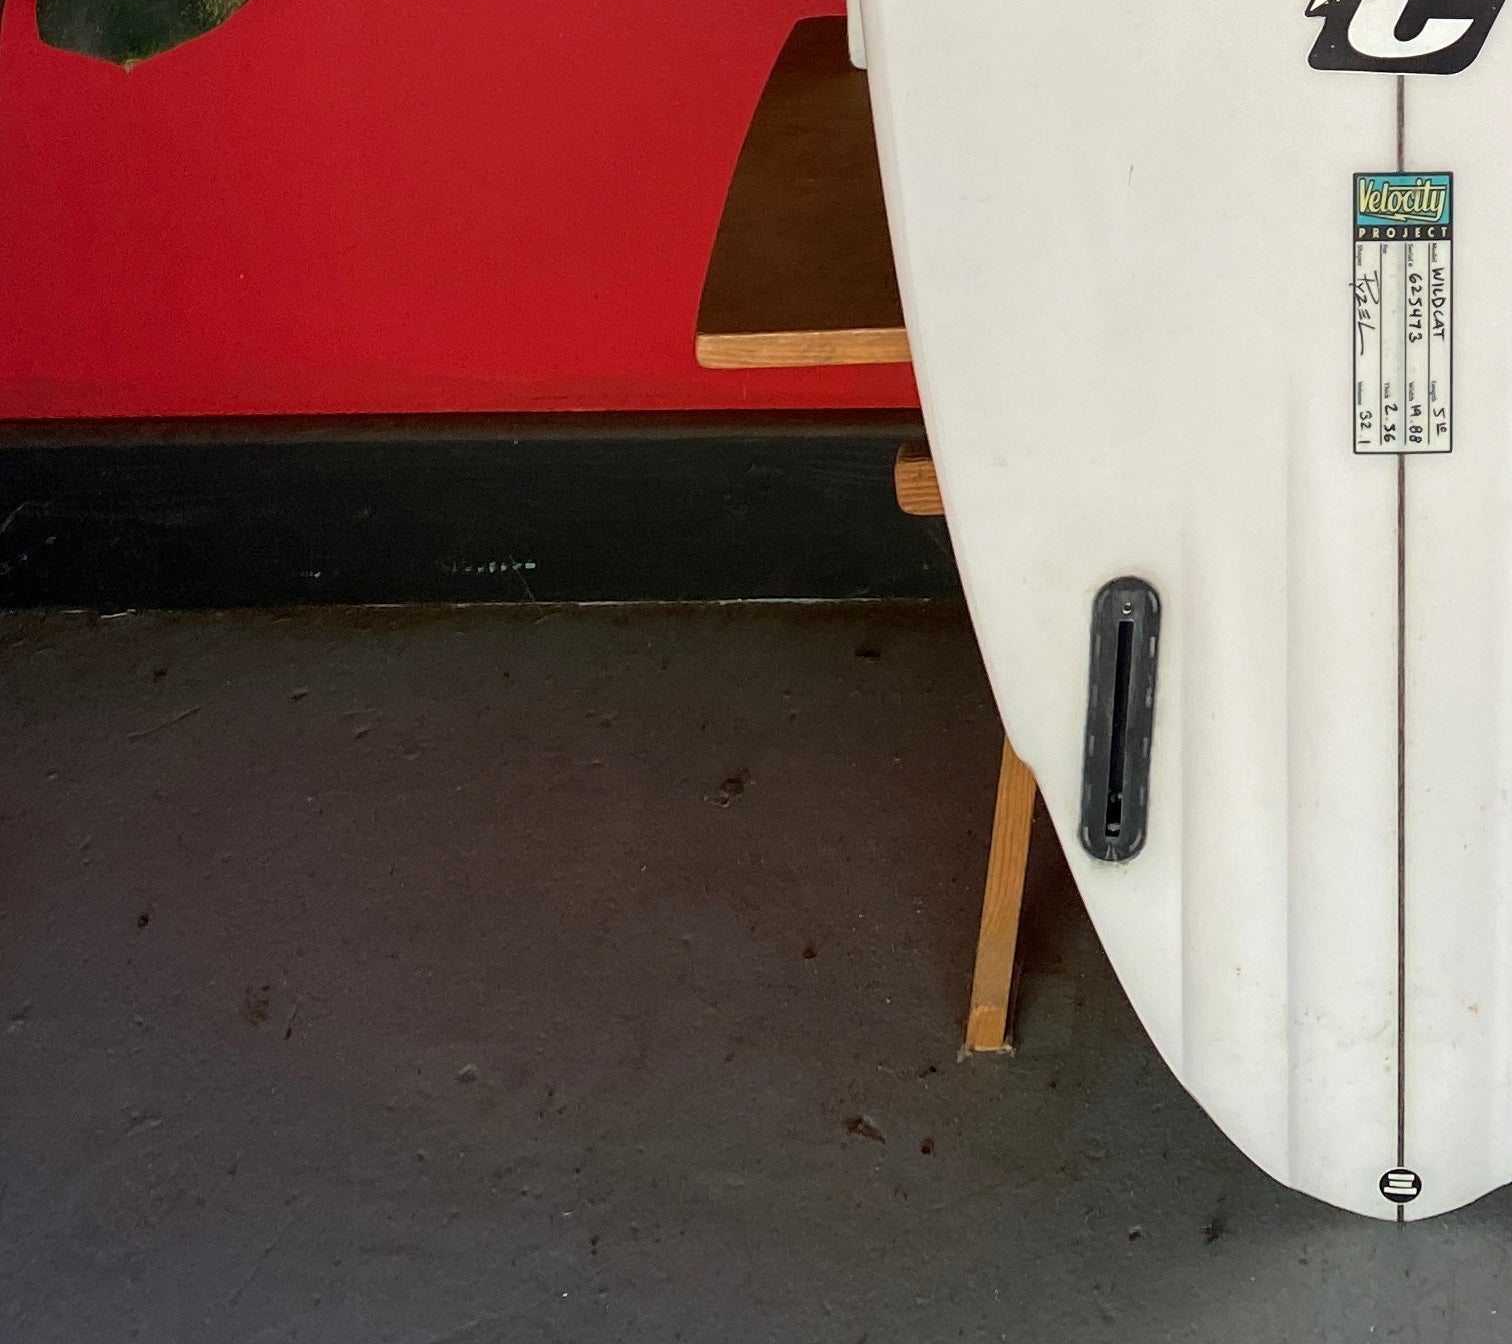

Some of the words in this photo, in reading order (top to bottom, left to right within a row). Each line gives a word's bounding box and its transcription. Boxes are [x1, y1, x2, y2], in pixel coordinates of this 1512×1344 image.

[1358, 177, 1447, 223] Velocity
[1358, 227, 1447, 238] PROJECT
[1408, 272, 1423, 344] 625473
[1431, 267, 1446, 342] WILDCAT
